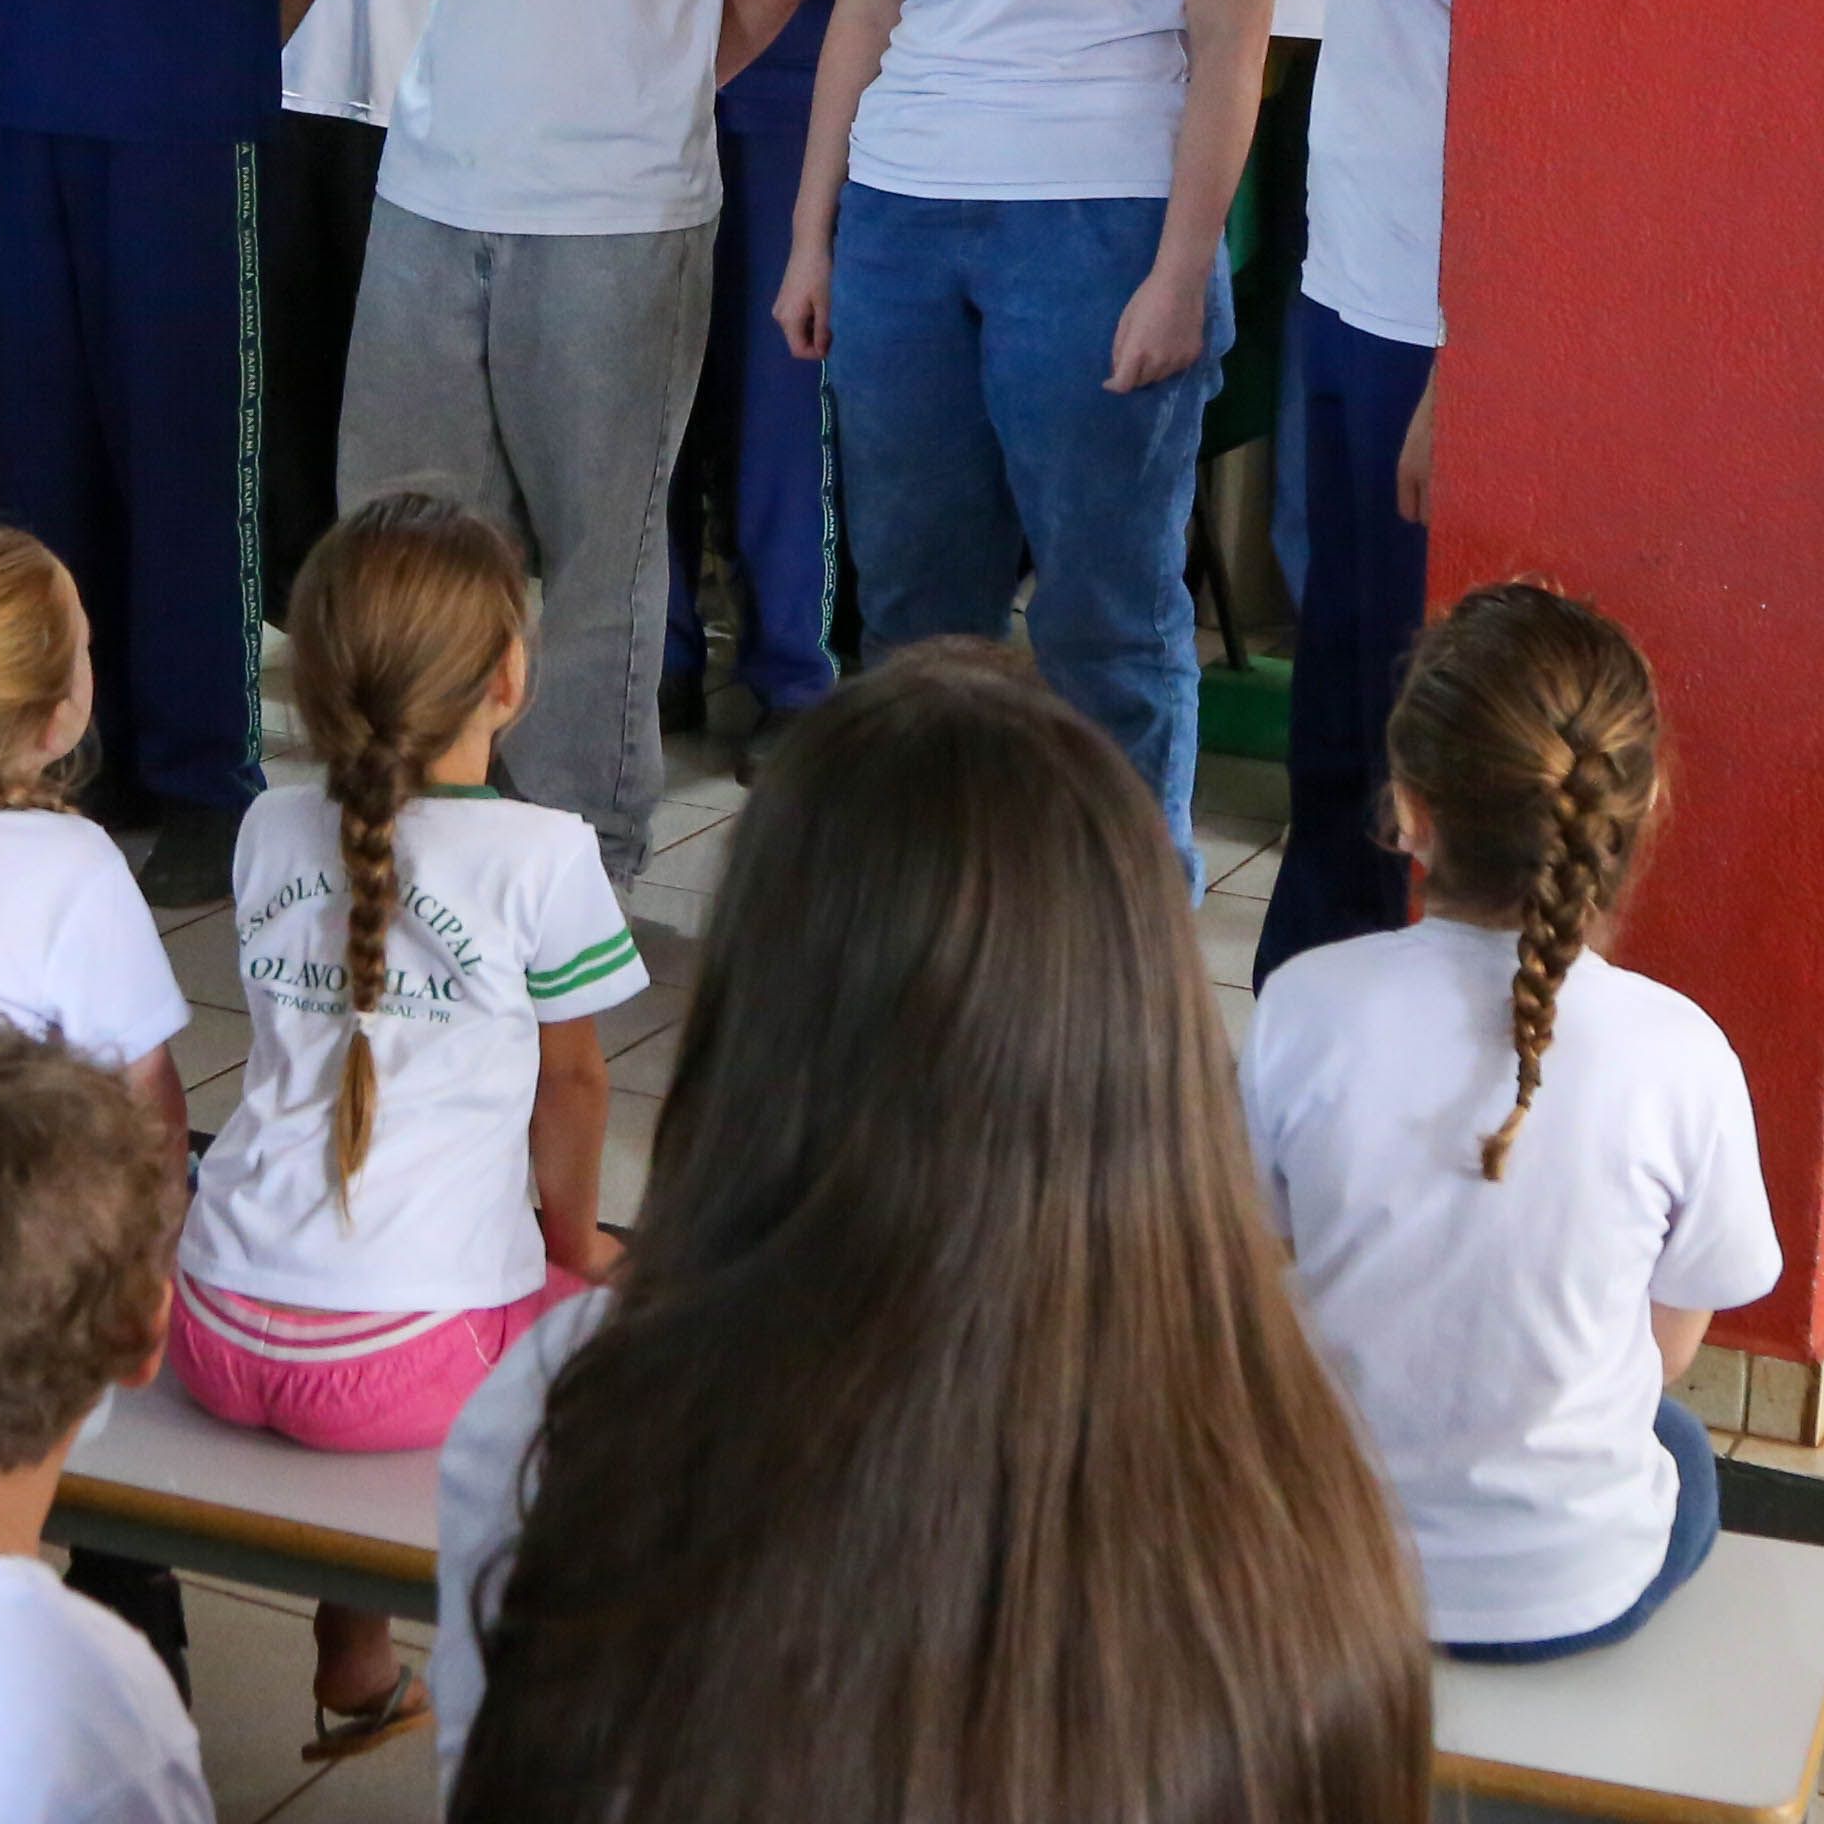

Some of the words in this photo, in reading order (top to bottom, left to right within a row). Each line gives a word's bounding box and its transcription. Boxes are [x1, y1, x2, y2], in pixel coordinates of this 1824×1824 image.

[239, 871, 332, 947] ESCOLA
[249, 956, 348, 993] OLAVO
[384, 969, 467, 1003] ILAC
